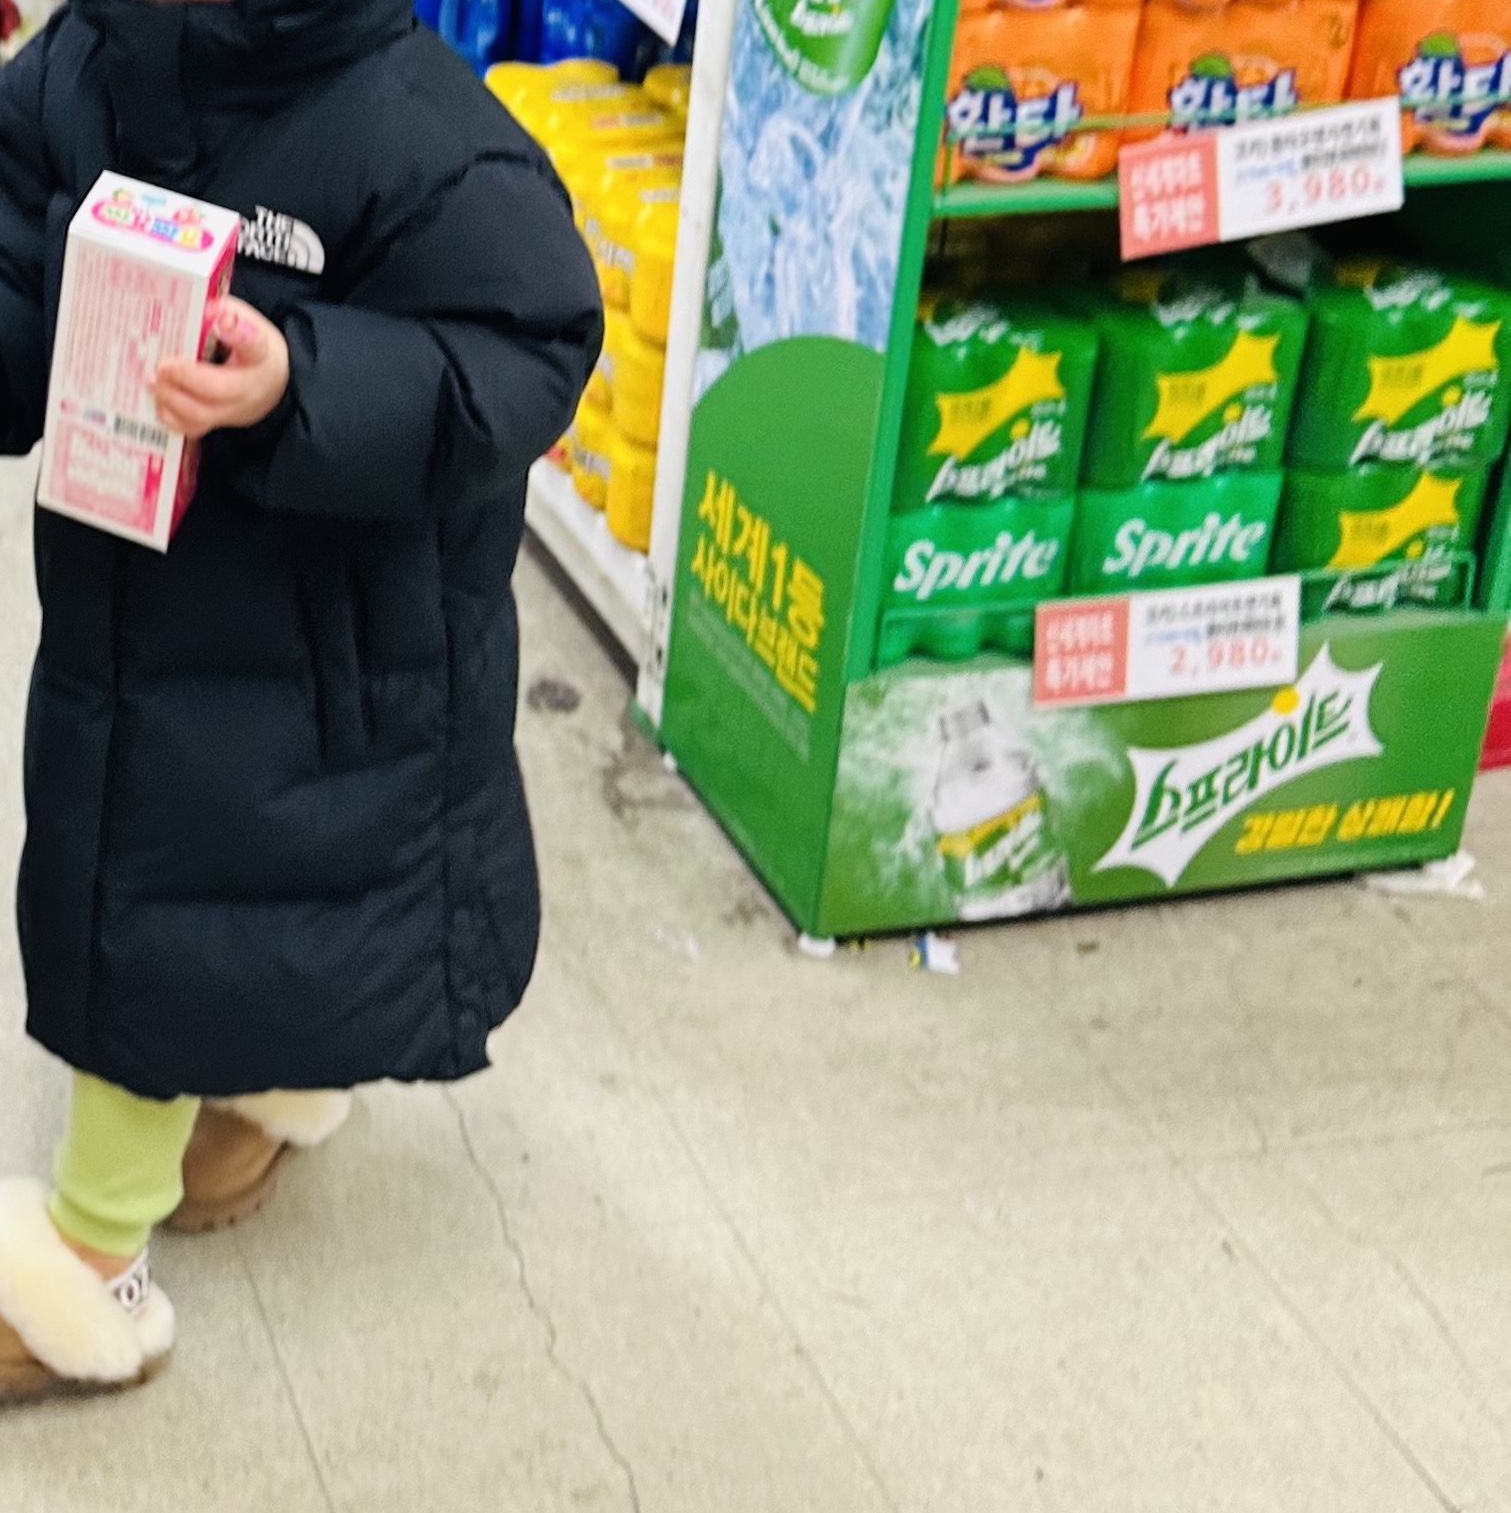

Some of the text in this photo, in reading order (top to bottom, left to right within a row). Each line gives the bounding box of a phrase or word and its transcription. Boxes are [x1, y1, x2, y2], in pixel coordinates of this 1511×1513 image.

[949, 84, 1081, 158] 환타
[1265, 165, 1372, 215] 3,980
[239, 217, 291, 252] ORTH
[255, 205, 294, 235] THE
[894, 530, 1059, 599] Sprite
[1102, 512, 1268, 578] Sprite
[1168, 635, 1271, 677] 2,980
[1130, 689, 1353, 851] 스프라이트
